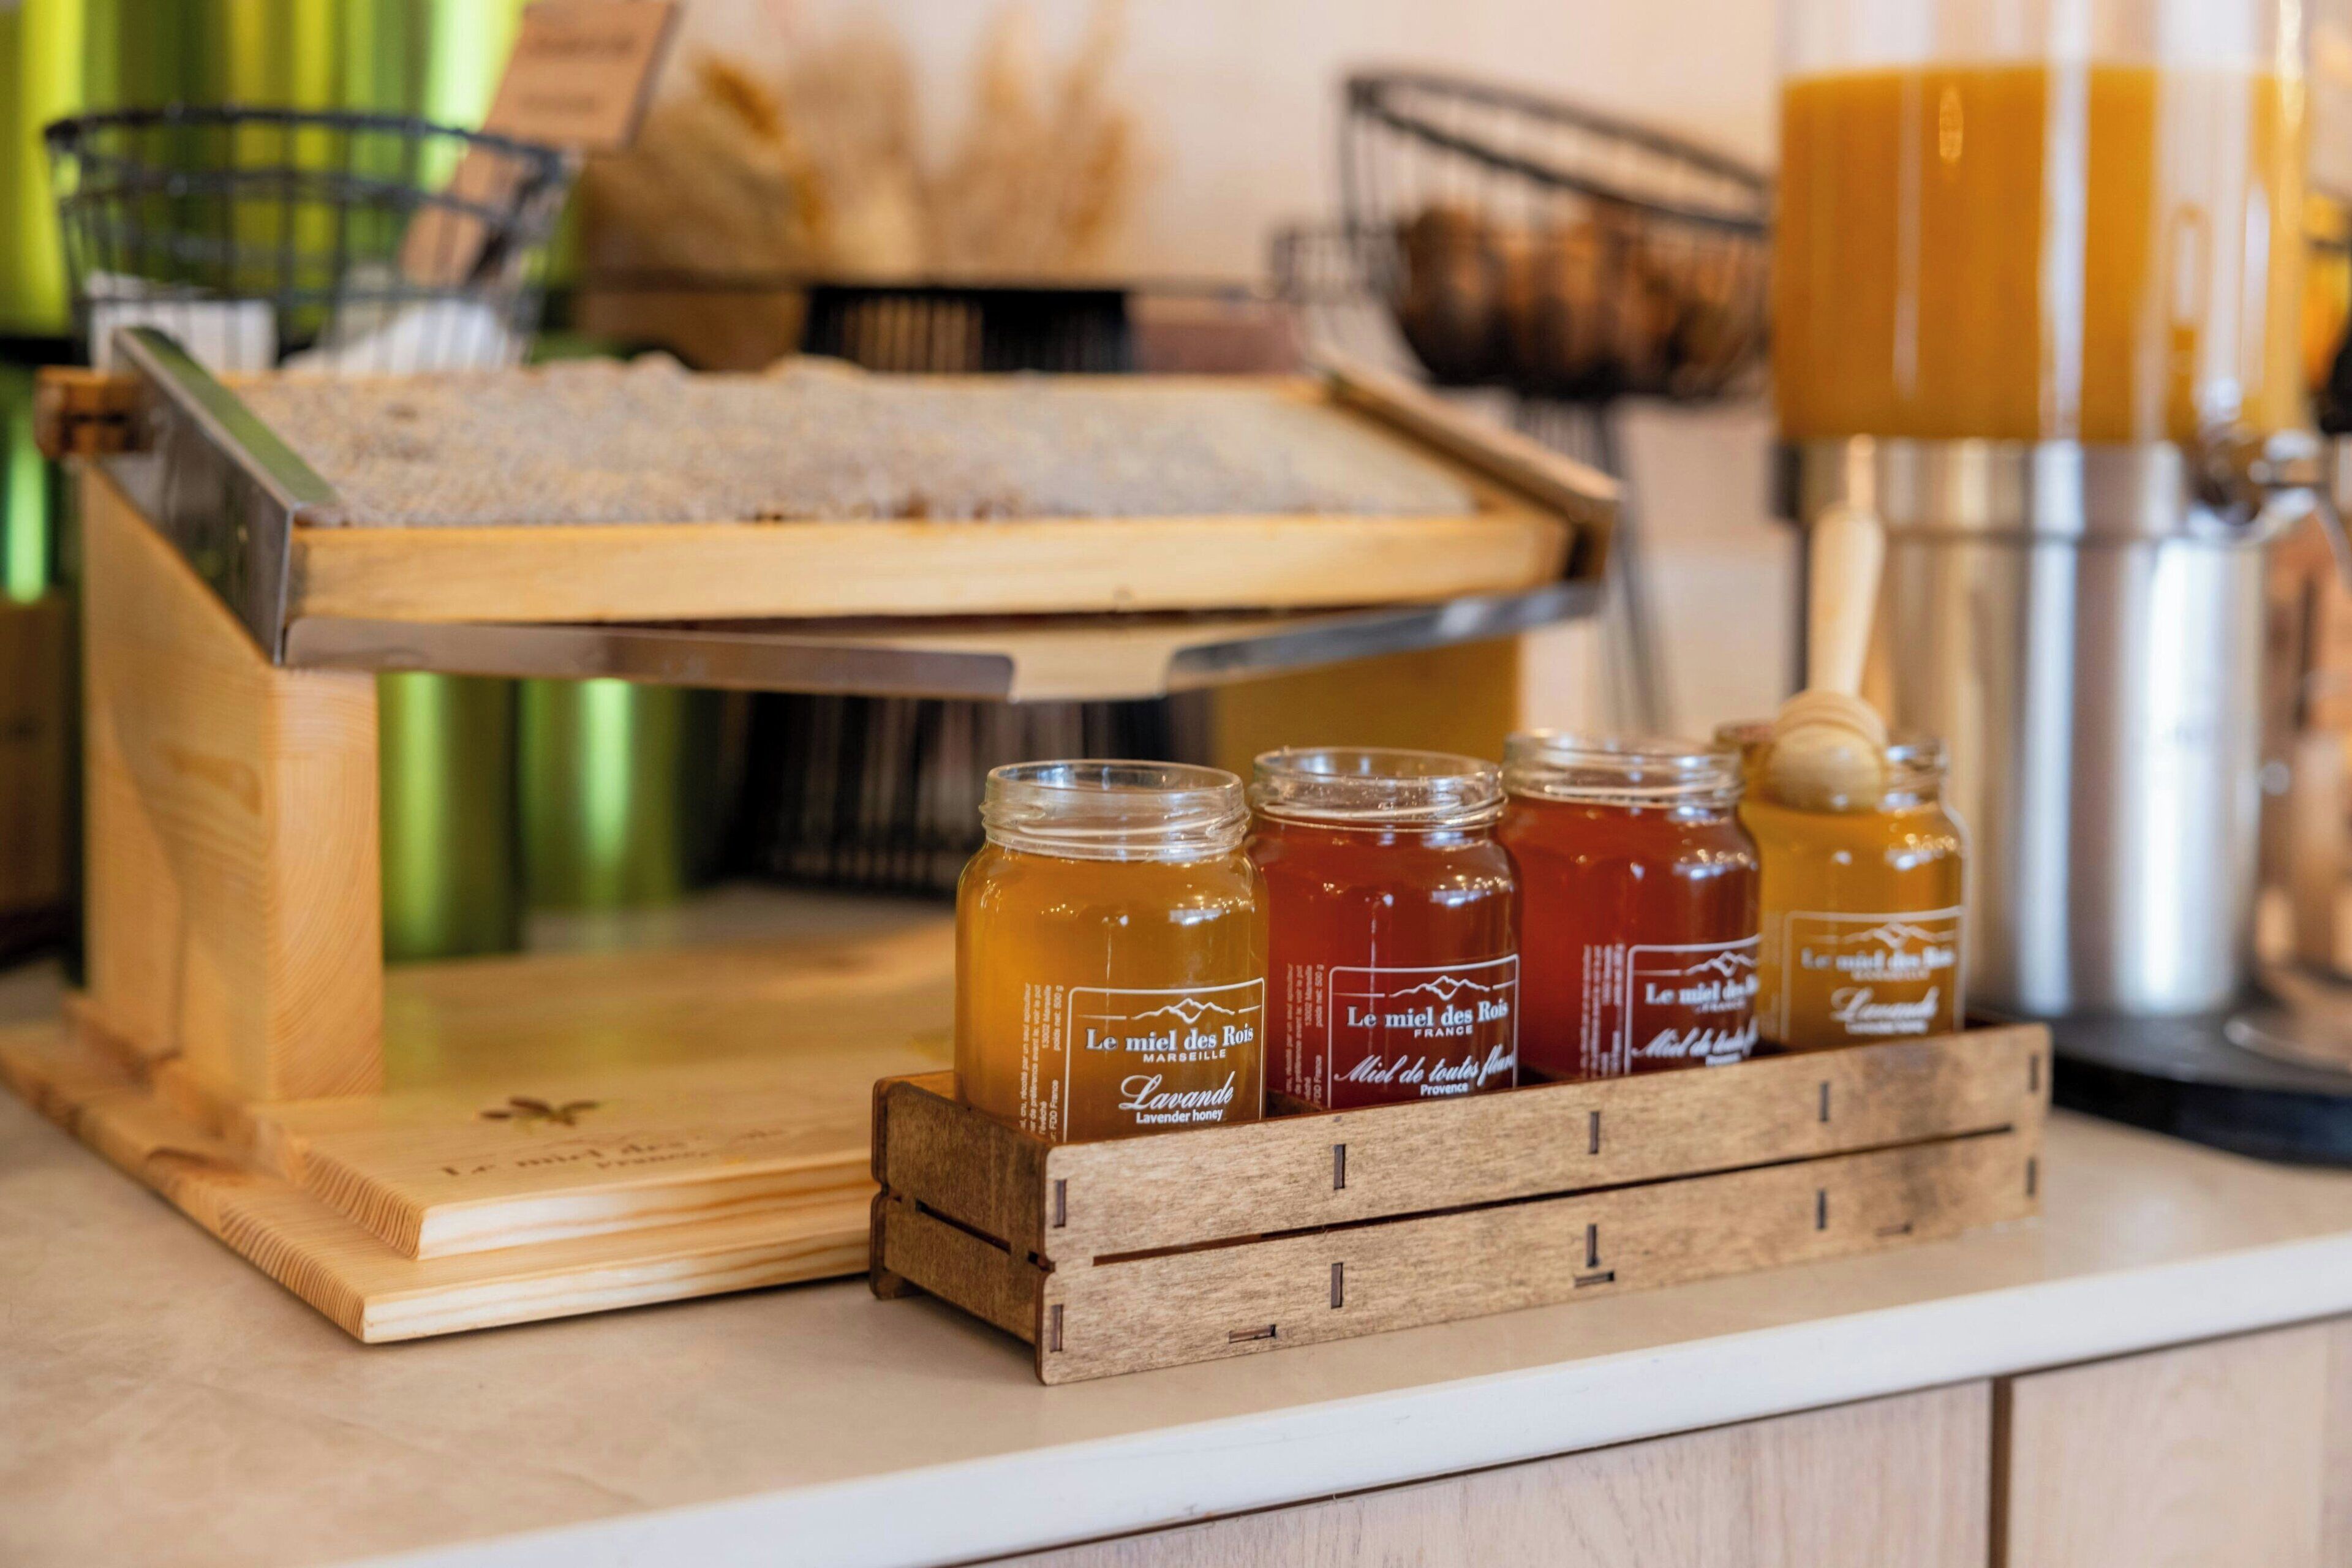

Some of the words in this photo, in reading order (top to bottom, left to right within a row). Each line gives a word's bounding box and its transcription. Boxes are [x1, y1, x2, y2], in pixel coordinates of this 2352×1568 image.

[1054, 993, 1062, 1009] 500
[1645, 982, 1675, 1005] Le
[1347, 1006, 1377, 1028] Le
[1385, 1006, 1434, 1028] miel
[1440, 1003, 1473, 1027] des
[1477, 998, 1509, 1023] Rois
[1053, 1028, 1061, 1051] poids
[1085, 1028, 1118, 1051] Le
[1125, 1029, 1177, 1052] miel
[1183, 1027, 1217, 1050] des
[1222, 1022, 1254, 1047] Rois
[1414, 1025, 1473, 1038] FRANCE
[1143, 1049, 1226, 1063] MARSEILLE
[1333, 1054, 1408, 1083] Miel
[1399, 1056, 1426, 1084] de
[1429, 1055, 1479, 1082] toutes
[1049, 1080, 1058, 1109] France
[1118, 1071, 1236, 1110] Lavande
[1420, 1082, 1469, 1096] Provence
[1049, 1110, 1058, 1129] FDD
[1136, 1109, 1191, 1125] Lavender
[1193, 1109, 1223, 1122] honey
